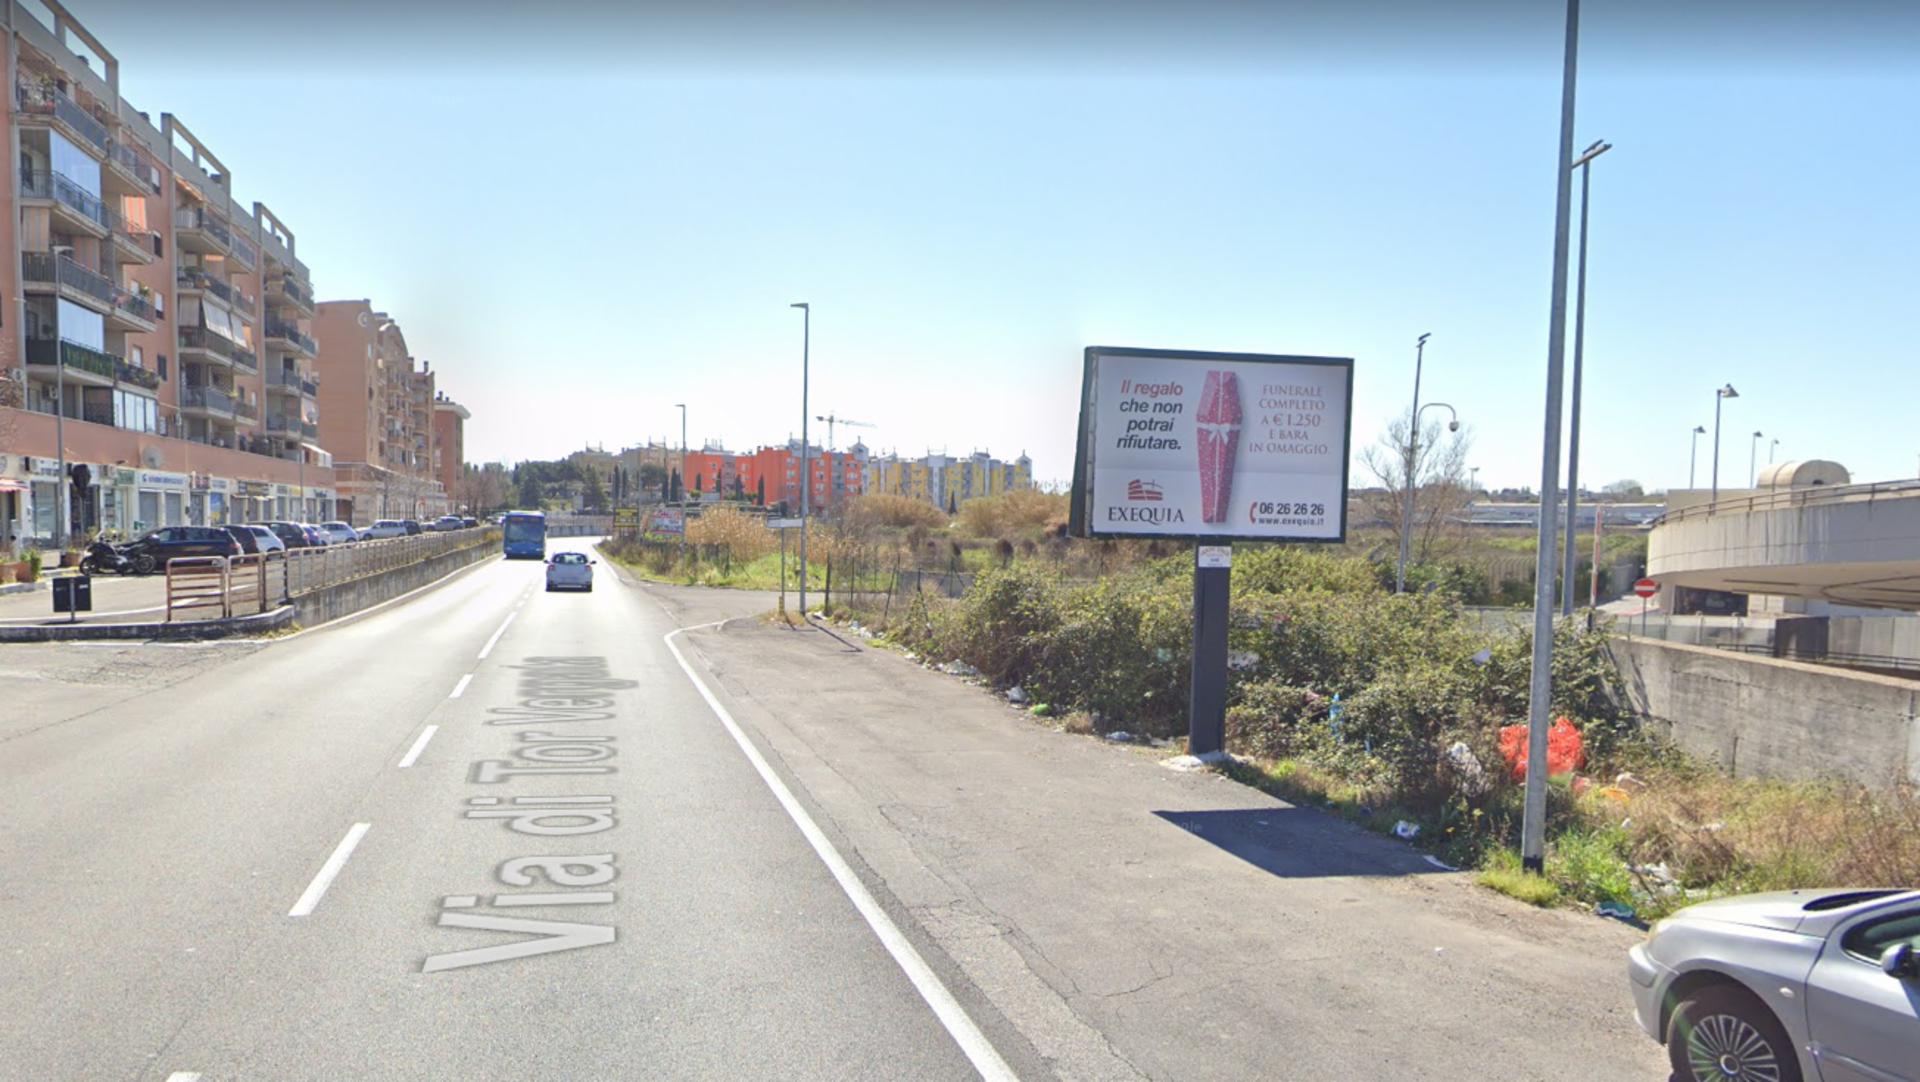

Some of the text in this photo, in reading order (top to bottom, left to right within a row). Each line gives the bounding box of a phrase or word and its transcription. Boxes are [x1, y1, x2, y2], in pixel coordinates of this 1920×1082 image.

[1120, 379, 1183, 398] Il regalo
[1262, 384, 1322, 397] FUNERALE
[1119, 398, 1183, 414] che non
[1258, 398, 1326, 410] COMPLETO
[1126, 417, 1174, 433] potrai
[1261, 415, 1269, 425] A
[1272, 413, 1284, 426] €
[1116, 434, 1182, 450] rifiutare.
[1269, 428, 1309, 441] E BARA
[1249, 442, 1264, 453] IN
[1108, 506, 1185, 526] EXEQUIA
[1259, 501, 1325, 516] 06 26 26 26
